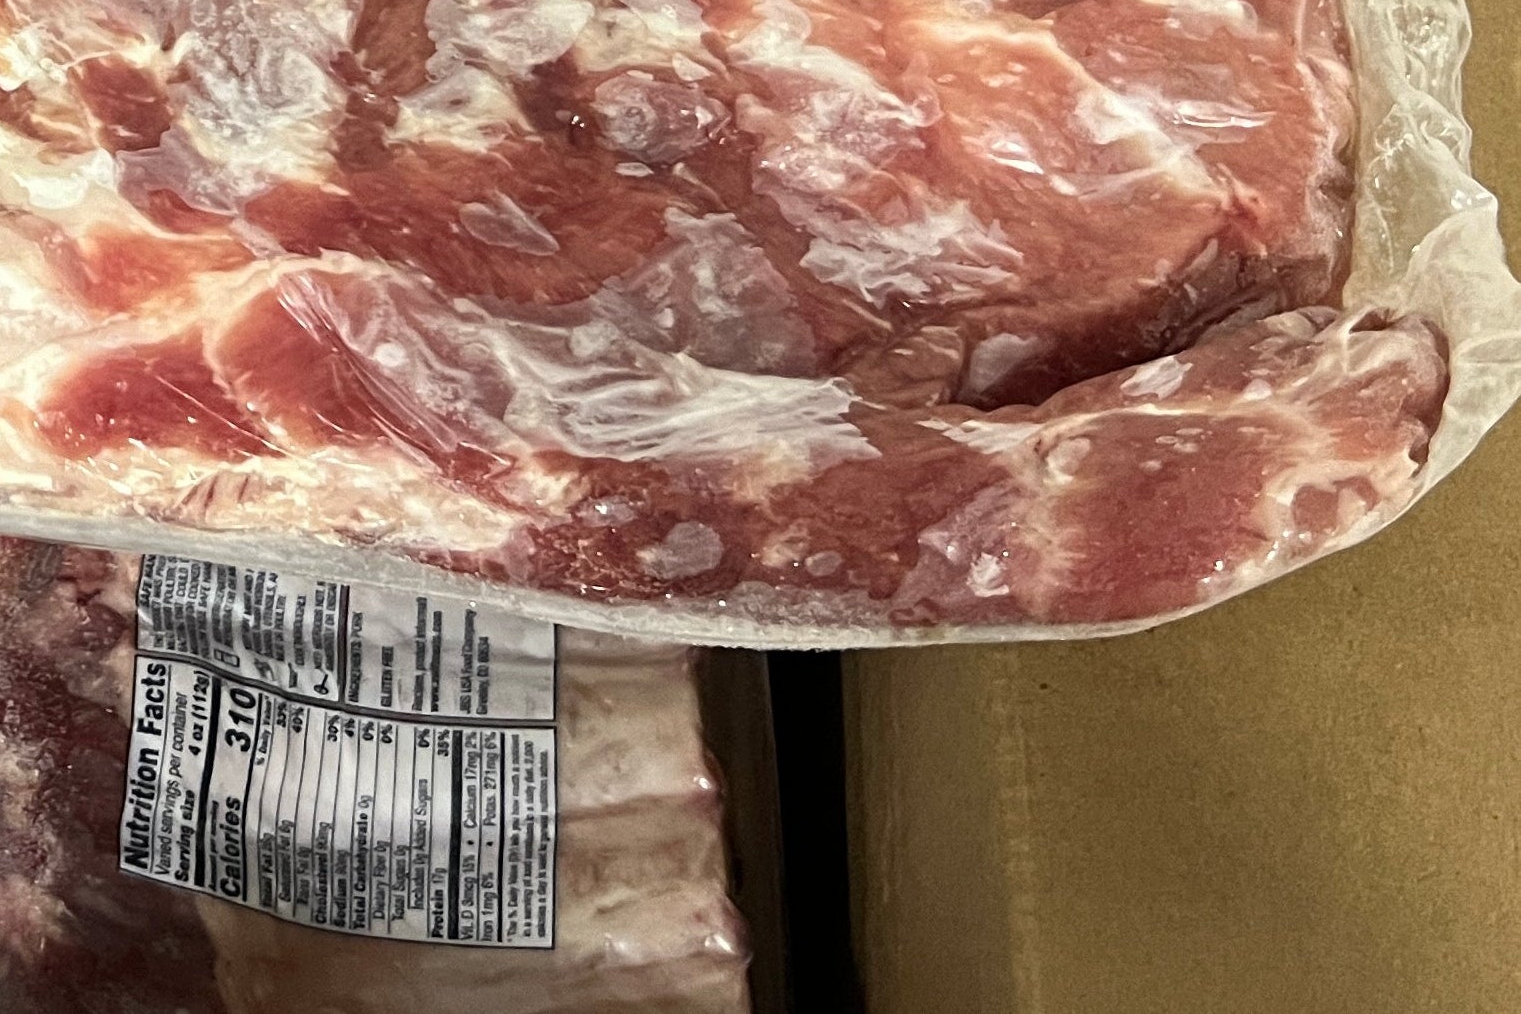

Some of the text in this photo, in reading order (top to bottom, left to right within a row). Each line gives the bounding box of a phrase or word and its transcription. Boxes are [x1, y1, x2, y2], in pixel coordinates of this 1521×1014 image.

[190, 669, 210, 721] (112g)
[192, 722, 204, 742] oz
[328, 713, 340, 743] 30%
[362, 720, 374, 742] 0%
[381, 723, 393, 745] 0%
[418, 728, 430, 749] 0%
[485, 731, 498, 750] 6%
[189, 744, 201, 757] 4
[464, 750, 480, 780] 17mg
[123, 663, 167, 870] Nutrition Facts
[484, 751, 500, 790] 271mg
[154, 691, 188, 875] Varied servings per container
[219, 687, 256, 898] Calories 310
[180, 788, 196, 822] size
[358, 794, 373, 809] 0g
[464, 784, 478, 829] Calcium
[431, 729, 450, 939] Protein 17g 35%
[174, 824, 195, 884] Serving
[462, 854, 476, 874] 15%
[462, 876, 478, 908] 3mcg
[482, 871, 494, 889] 6%
[461, 909, 475, 919] D
[482, 891, 498, 916] 1mg
